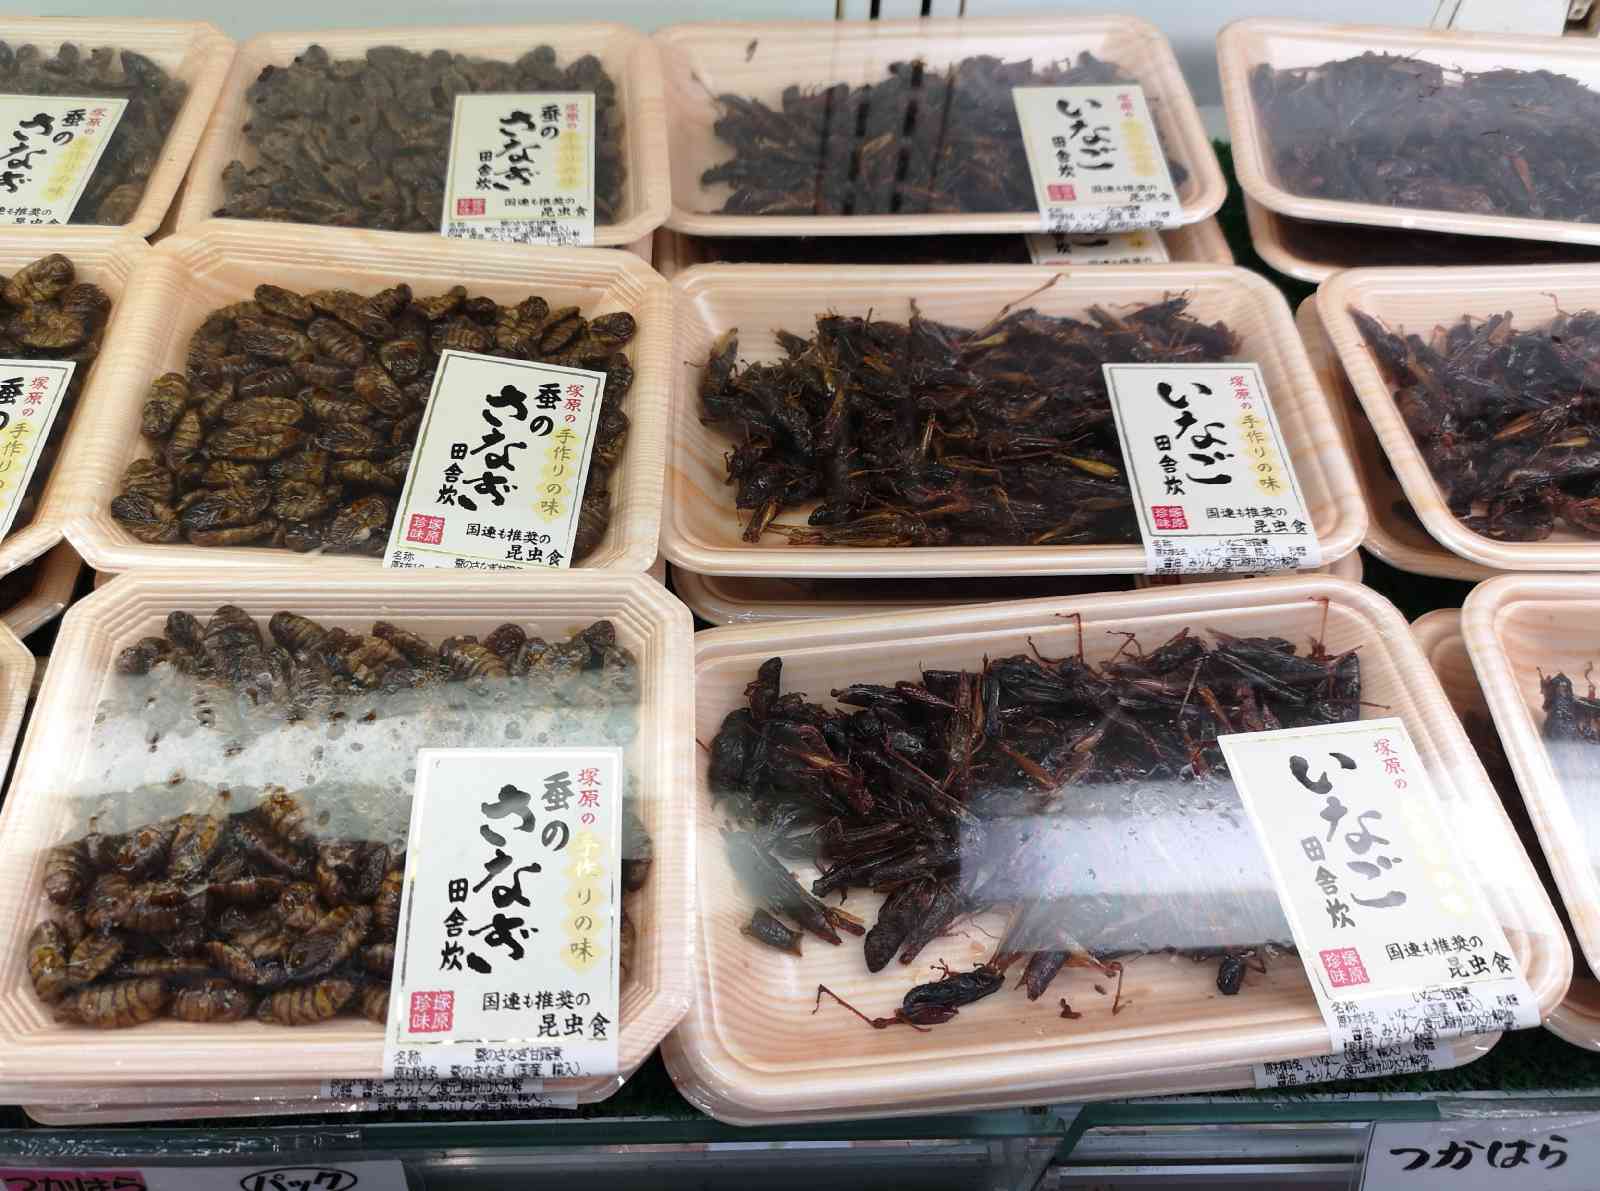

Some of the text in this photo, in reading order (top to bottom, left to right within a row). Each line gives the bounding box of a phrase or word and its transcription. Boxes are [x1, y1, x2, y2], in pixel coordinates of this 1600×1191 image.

[494, 109, 541, 191] さなぎ
[1056, 98, 1117, 170] いなご
[530, 383, 562, 437] 蚕の
[1157, 382, 1234, 485] いなご
[436, 443, 468, 506] 田舎炊
[458, 385, 528, 511] さなぎ
[1155, 435, 1186, 495] 田舎炊
[465, 523, 551, 546] 国連も推奨の
[505, 544, 565, 566] 昆虫食
[1254, 520, 1307, 534] 昆虫食
[540, 771, 574, 852] 蚕の
[1290, 751, 1408, 909] いなご
[467, 785, 542, 974] さなぎ
[1300, 836, 1356, 929] 田舎炊
[440, 879, 469, 971] 田舎炊
[1385, 935, 1484, 962] 国連も推奨の
[1448, 951, 1513, 979] 昆虫食
[483, 990, 590, 1011] 国連も推奨の
[538, 1012, 611, 1038] 昆虫食
[1390, 1134, 1568, 1171] つかはら
